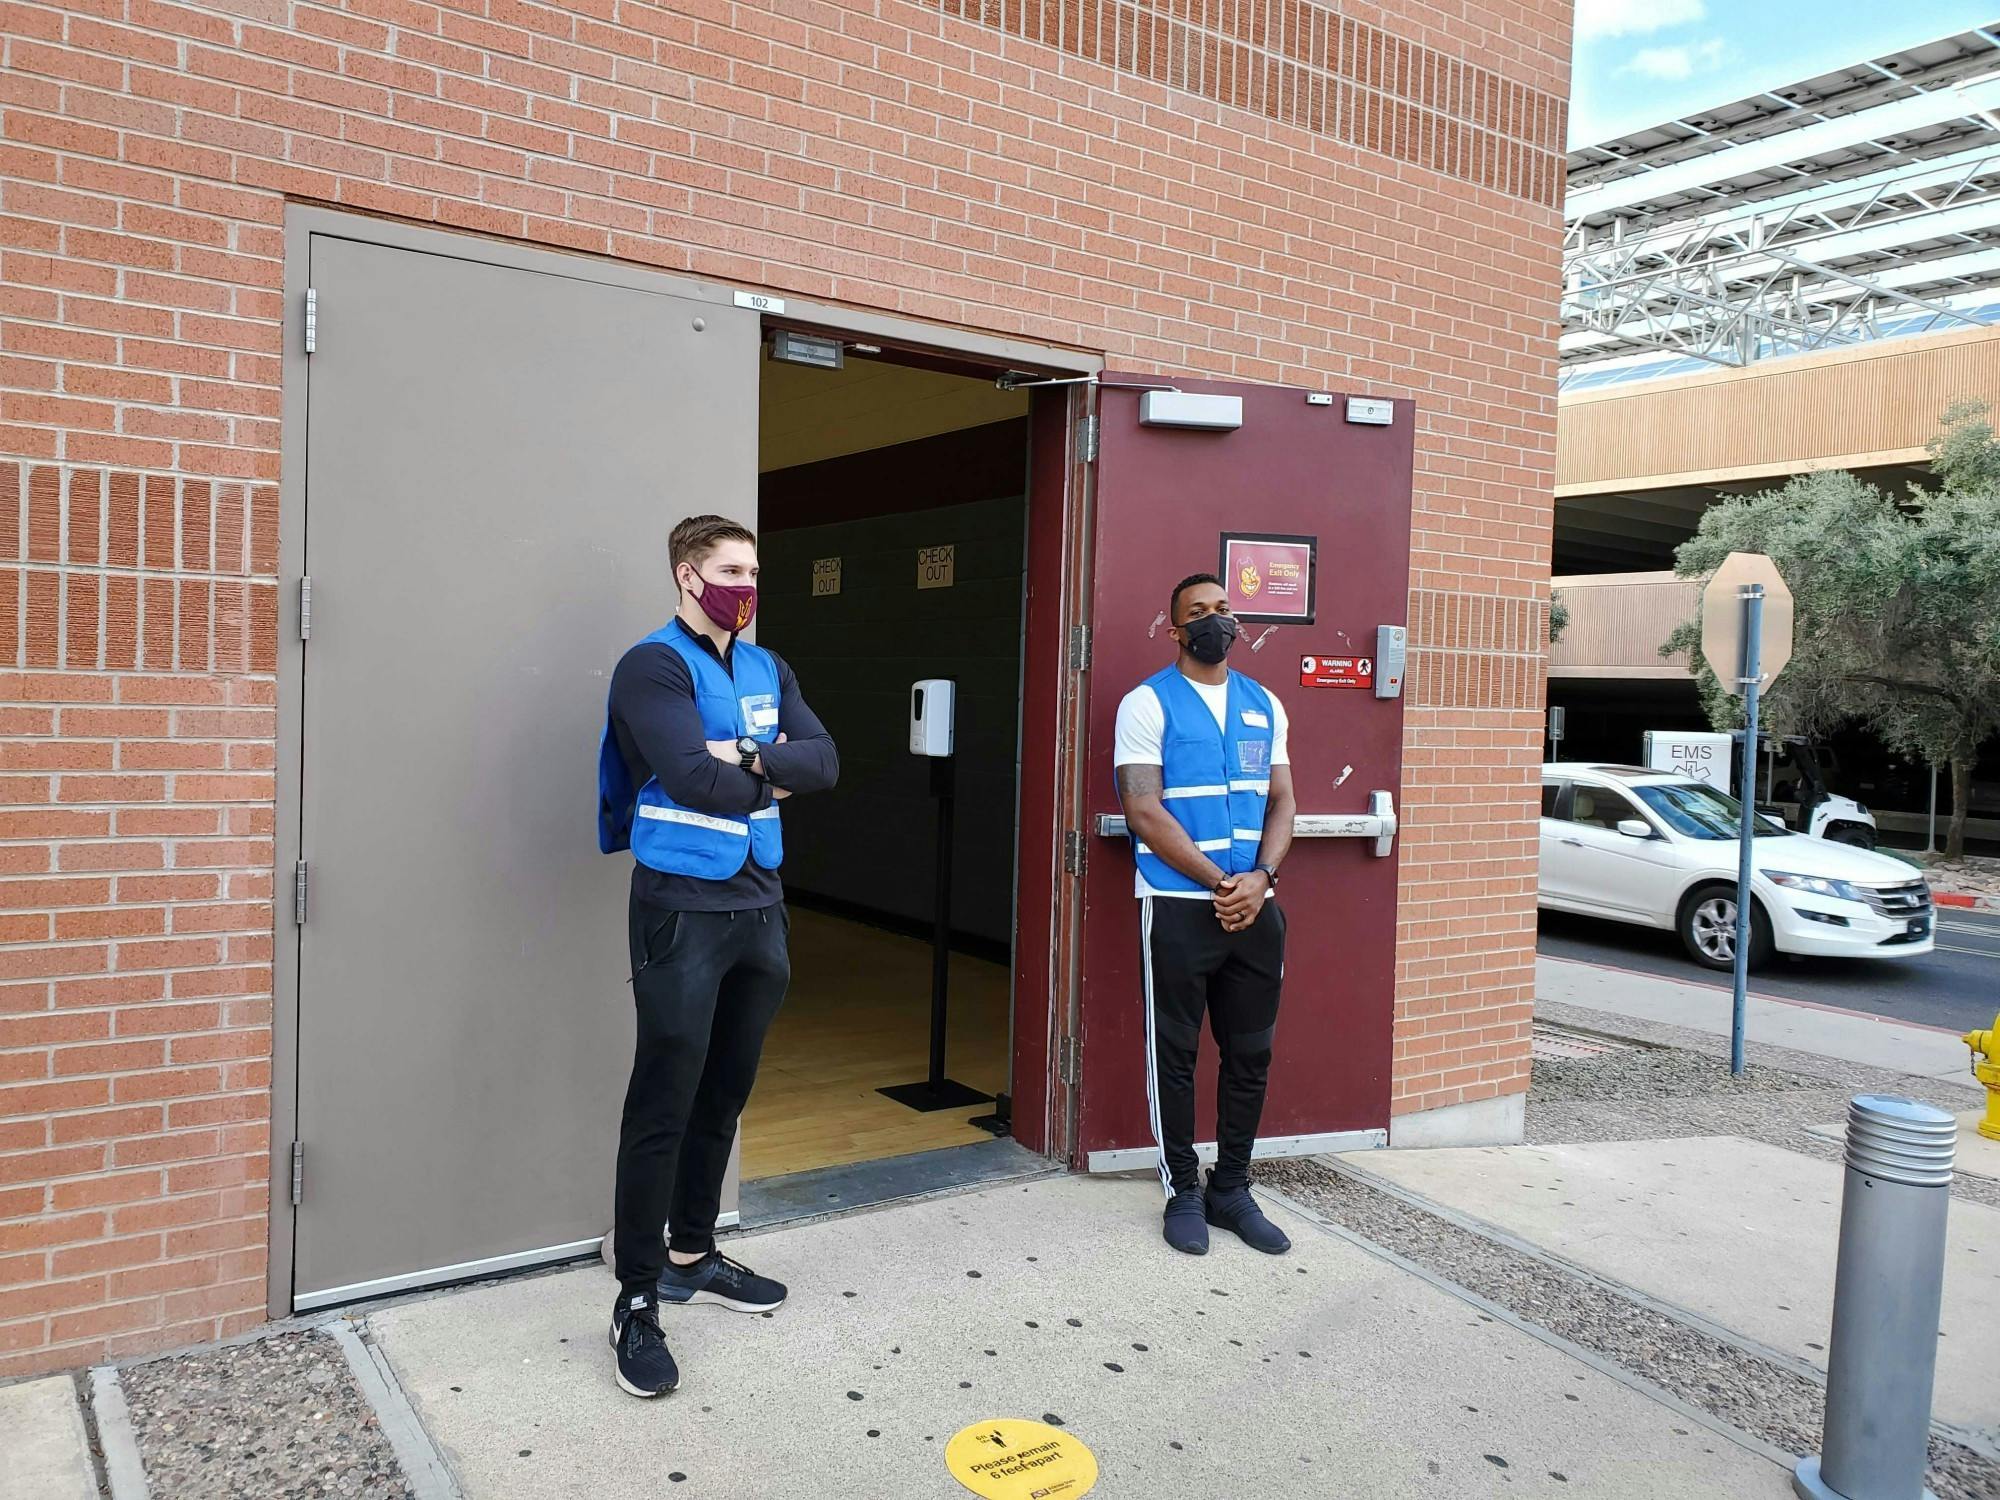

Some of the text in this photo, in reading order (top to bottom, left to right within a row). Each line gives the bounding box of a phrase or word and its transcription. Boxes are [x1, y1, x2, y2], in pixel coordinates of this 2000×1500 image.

[751, 296, 769, 309] 102
[917, 547, 953, 566] CHECK
[812, 558, 842, 575] CHECK
[925, 564, 948, 582] OUT
[1269, 569, 1300, 579] Exit Only
[818, 578, 837, 593] OUT
[1321, 659, 1353, 668] WARNING
[1671, 745, 1712, 759] EMS
[970, 1441, 1060, 1473] Please remain
[990, 1471, 1001, 1480] 6
[1028, 1452, 1063, 1467] apart
